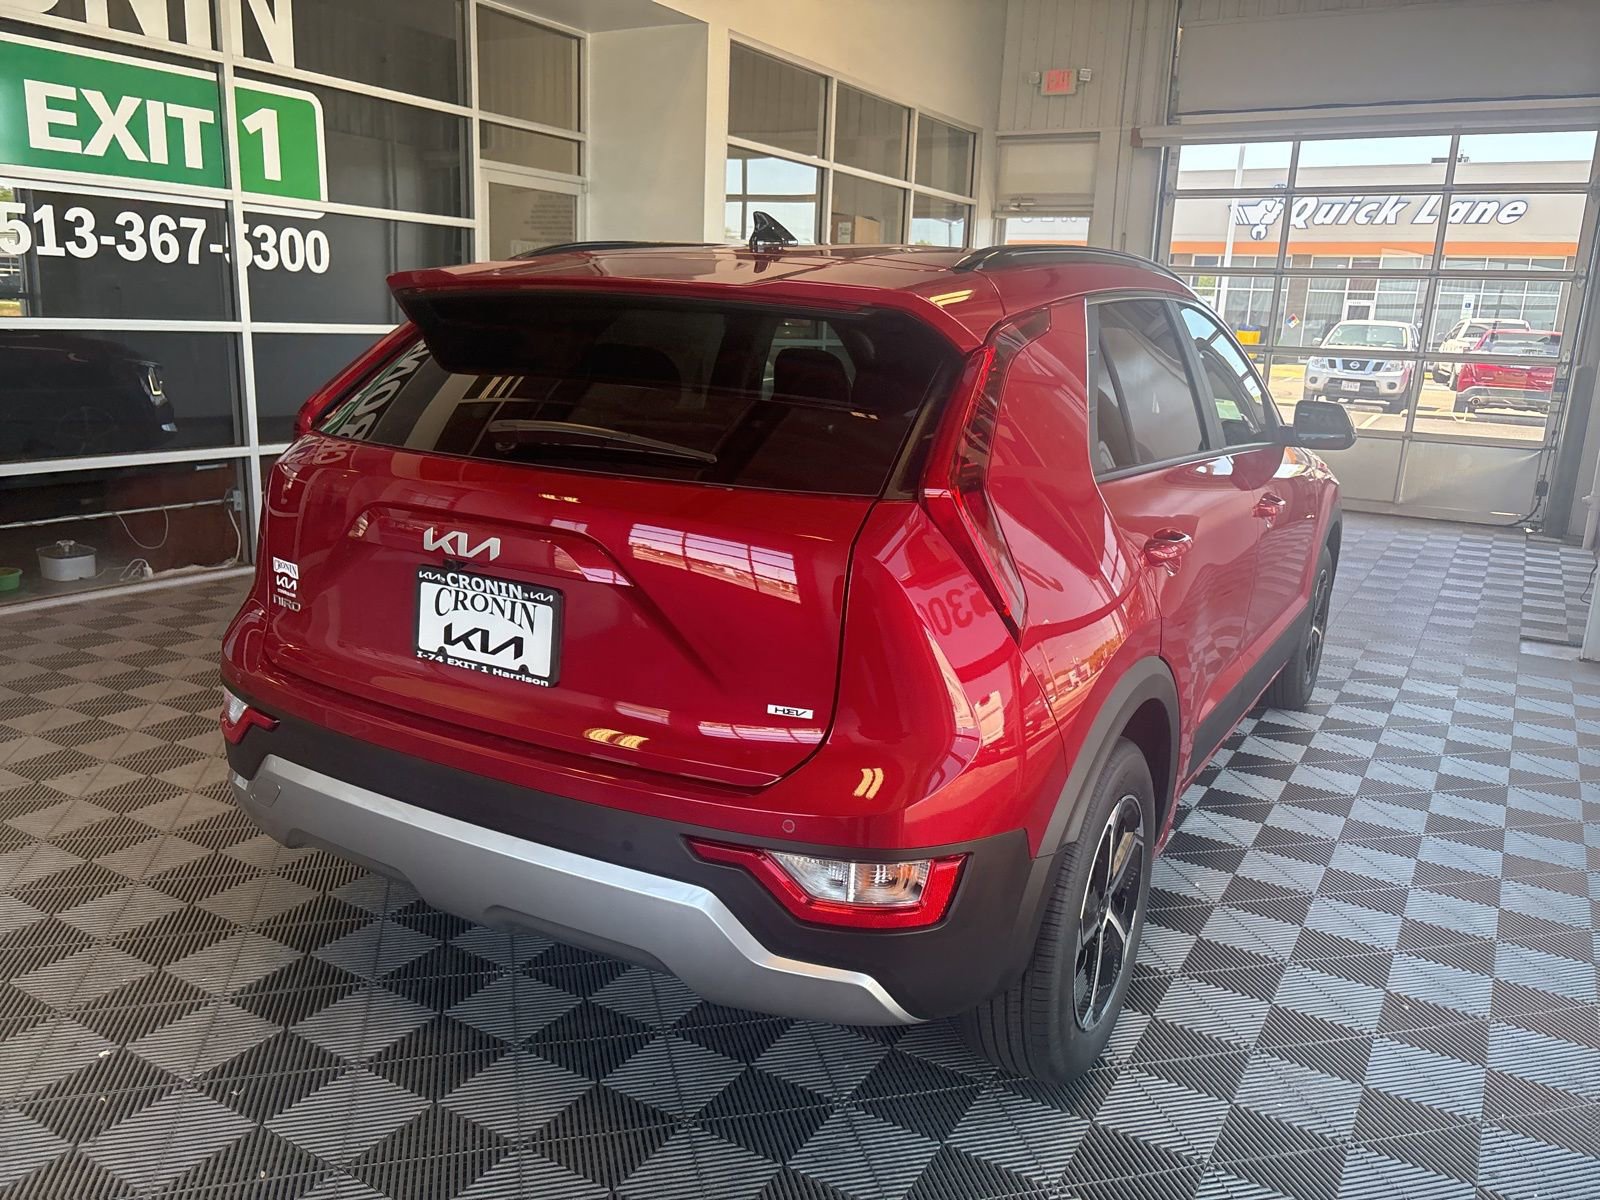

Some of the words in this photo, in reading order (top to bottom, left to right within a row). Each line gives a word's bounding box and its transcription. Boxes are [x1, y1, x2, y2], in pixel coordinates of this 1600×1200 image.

[24, 79, 214, 169] EXIT
[241, 107, 281, 182] 1
[1290, 196, 1409, 229] Quick
[1411, 195, 1529, 225] Lane
[424, 527, 500, 561] KIA
[447, 572, 522, 599] CRONIN
[435, 587, 538, 636] CRONIN
[444, 622, 523, 660] KIA
[417, 651, 444, 663] I-74
[447, 657, 478, 671] EXIT
[493, 667, 549, 687] Harrison
[775, 707, 807, 716] HEV
